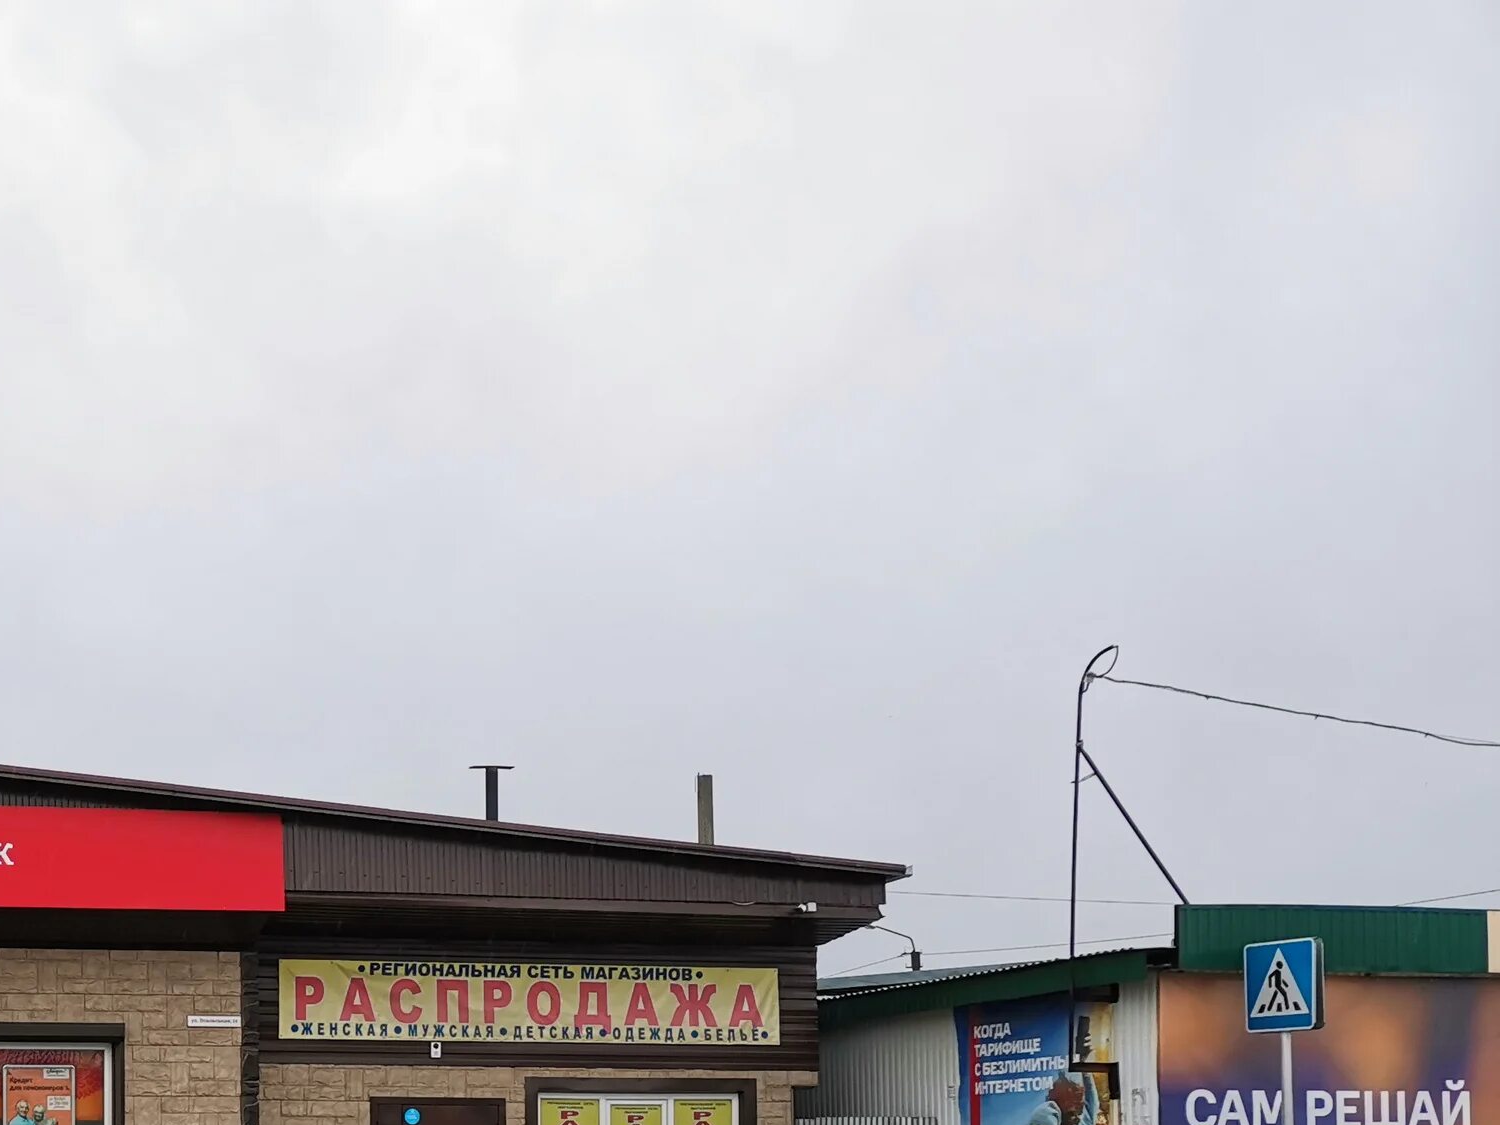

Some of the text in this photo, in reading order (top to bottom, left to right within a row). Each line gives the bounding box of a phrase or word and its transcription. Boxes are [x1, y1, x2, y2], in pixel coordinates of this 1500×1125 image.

[369, 963, 693, 981] РЕГИОНАЛЬНАЯ СЕТЬ МАГАЗИНОВ
[294, 976, 764, 1035] РАСПРОДАЖА
[301, 1022, 388, 1037] ЖЕНСКАЯ
[408, 1025, 494, 1038] МУЖСКАЯ
[513, 1025, 594, 1040] ДЕТСКАЯ
[613, 1027, 686, 1042] ОДЕЖДА
[973, 1023, 1011, 1039] КОГДА
[974, 1038, 1041, 1057] ТАРИФИЩЕ
[974, 1054, 1080, 1076] С БЕЗЛИМИТНЫ
[974, 1076, 1054, 1095] ИНТЕРНЕТОМ
